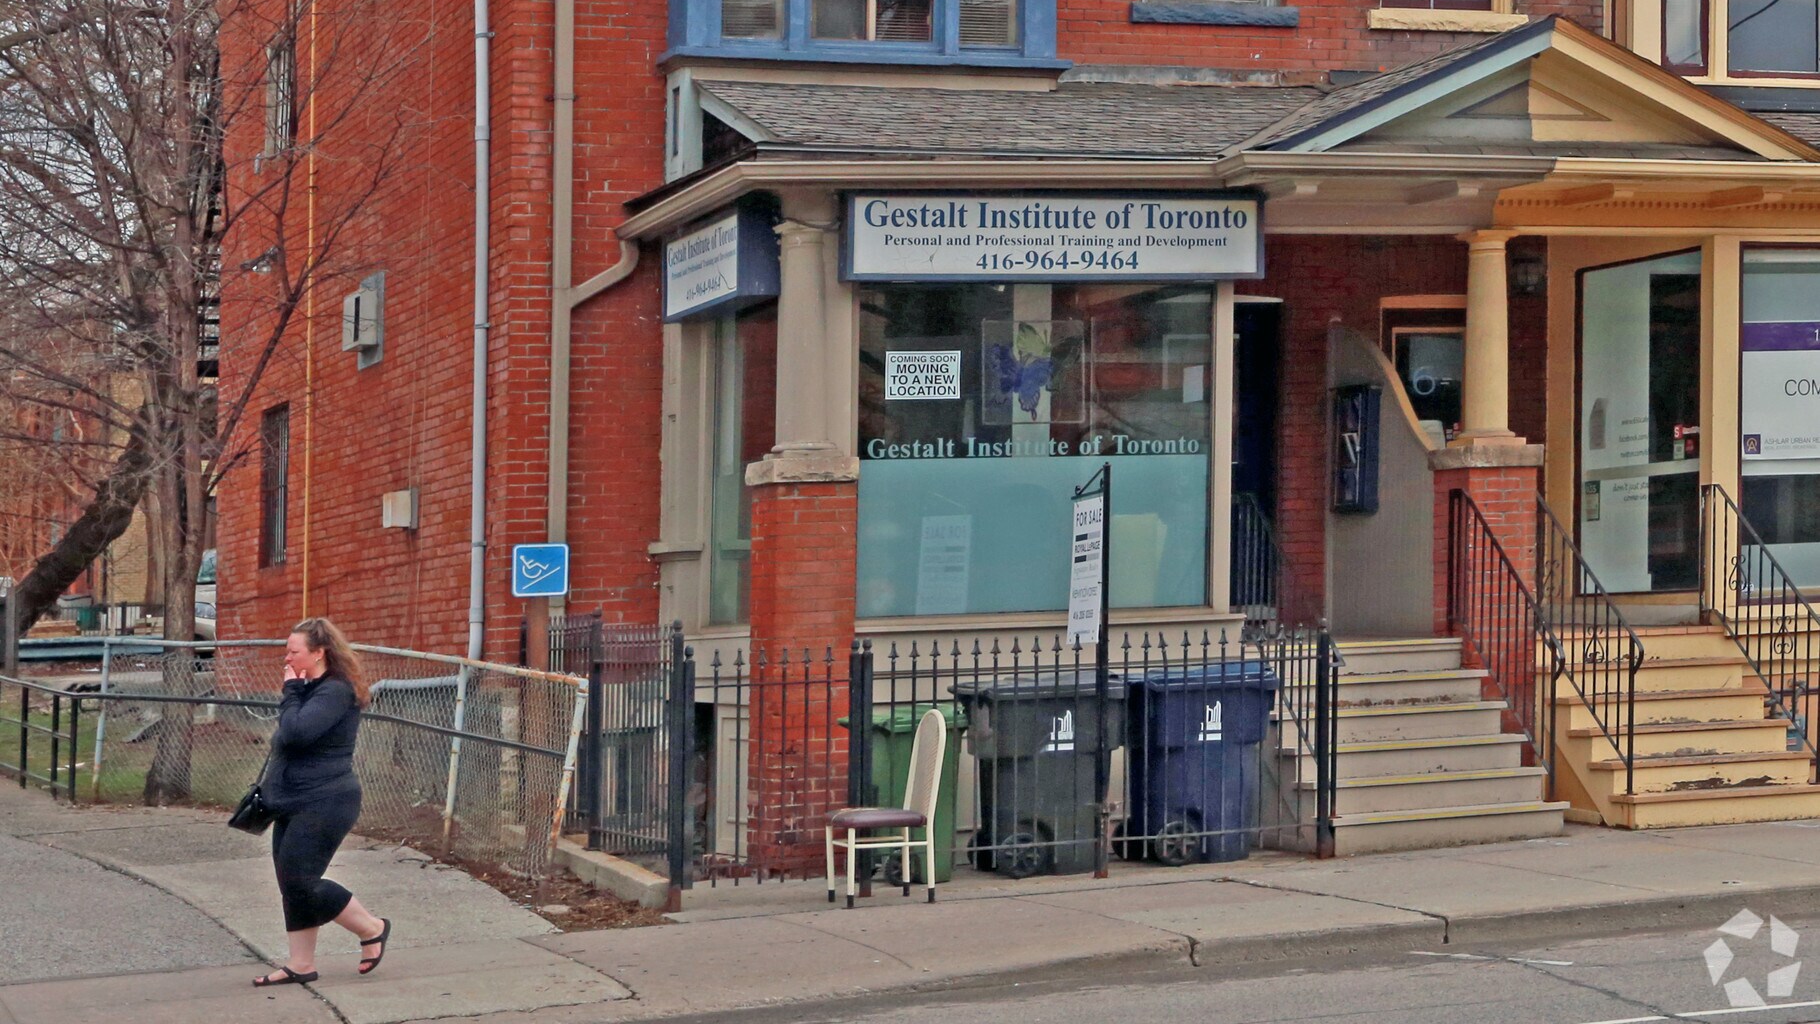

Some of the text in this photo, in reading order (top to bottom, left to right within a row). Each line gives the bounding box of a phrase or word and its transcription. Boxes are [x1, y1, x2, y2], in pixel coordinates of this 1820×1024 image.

[864, 199, 1248, 230] Gestalt Institute of Toronto
[884, 234, 1228, 249] Personal and Professional Training and Development
[976, 250, 1139, 271] 416-964-9464
[890, 354, 957, 364] COMING SOON
[896, 363, 950, 374] MOVING
[890, 375, 955, 385] TO A NEW
[889, 385, 957, 396] LOCATION
[1791, 436, 1811, 444] URBAN
[867, 435, 1200, 459] Gestalt Institute of Toronto
[1075, 508, 1102, 527] FOR SALE
